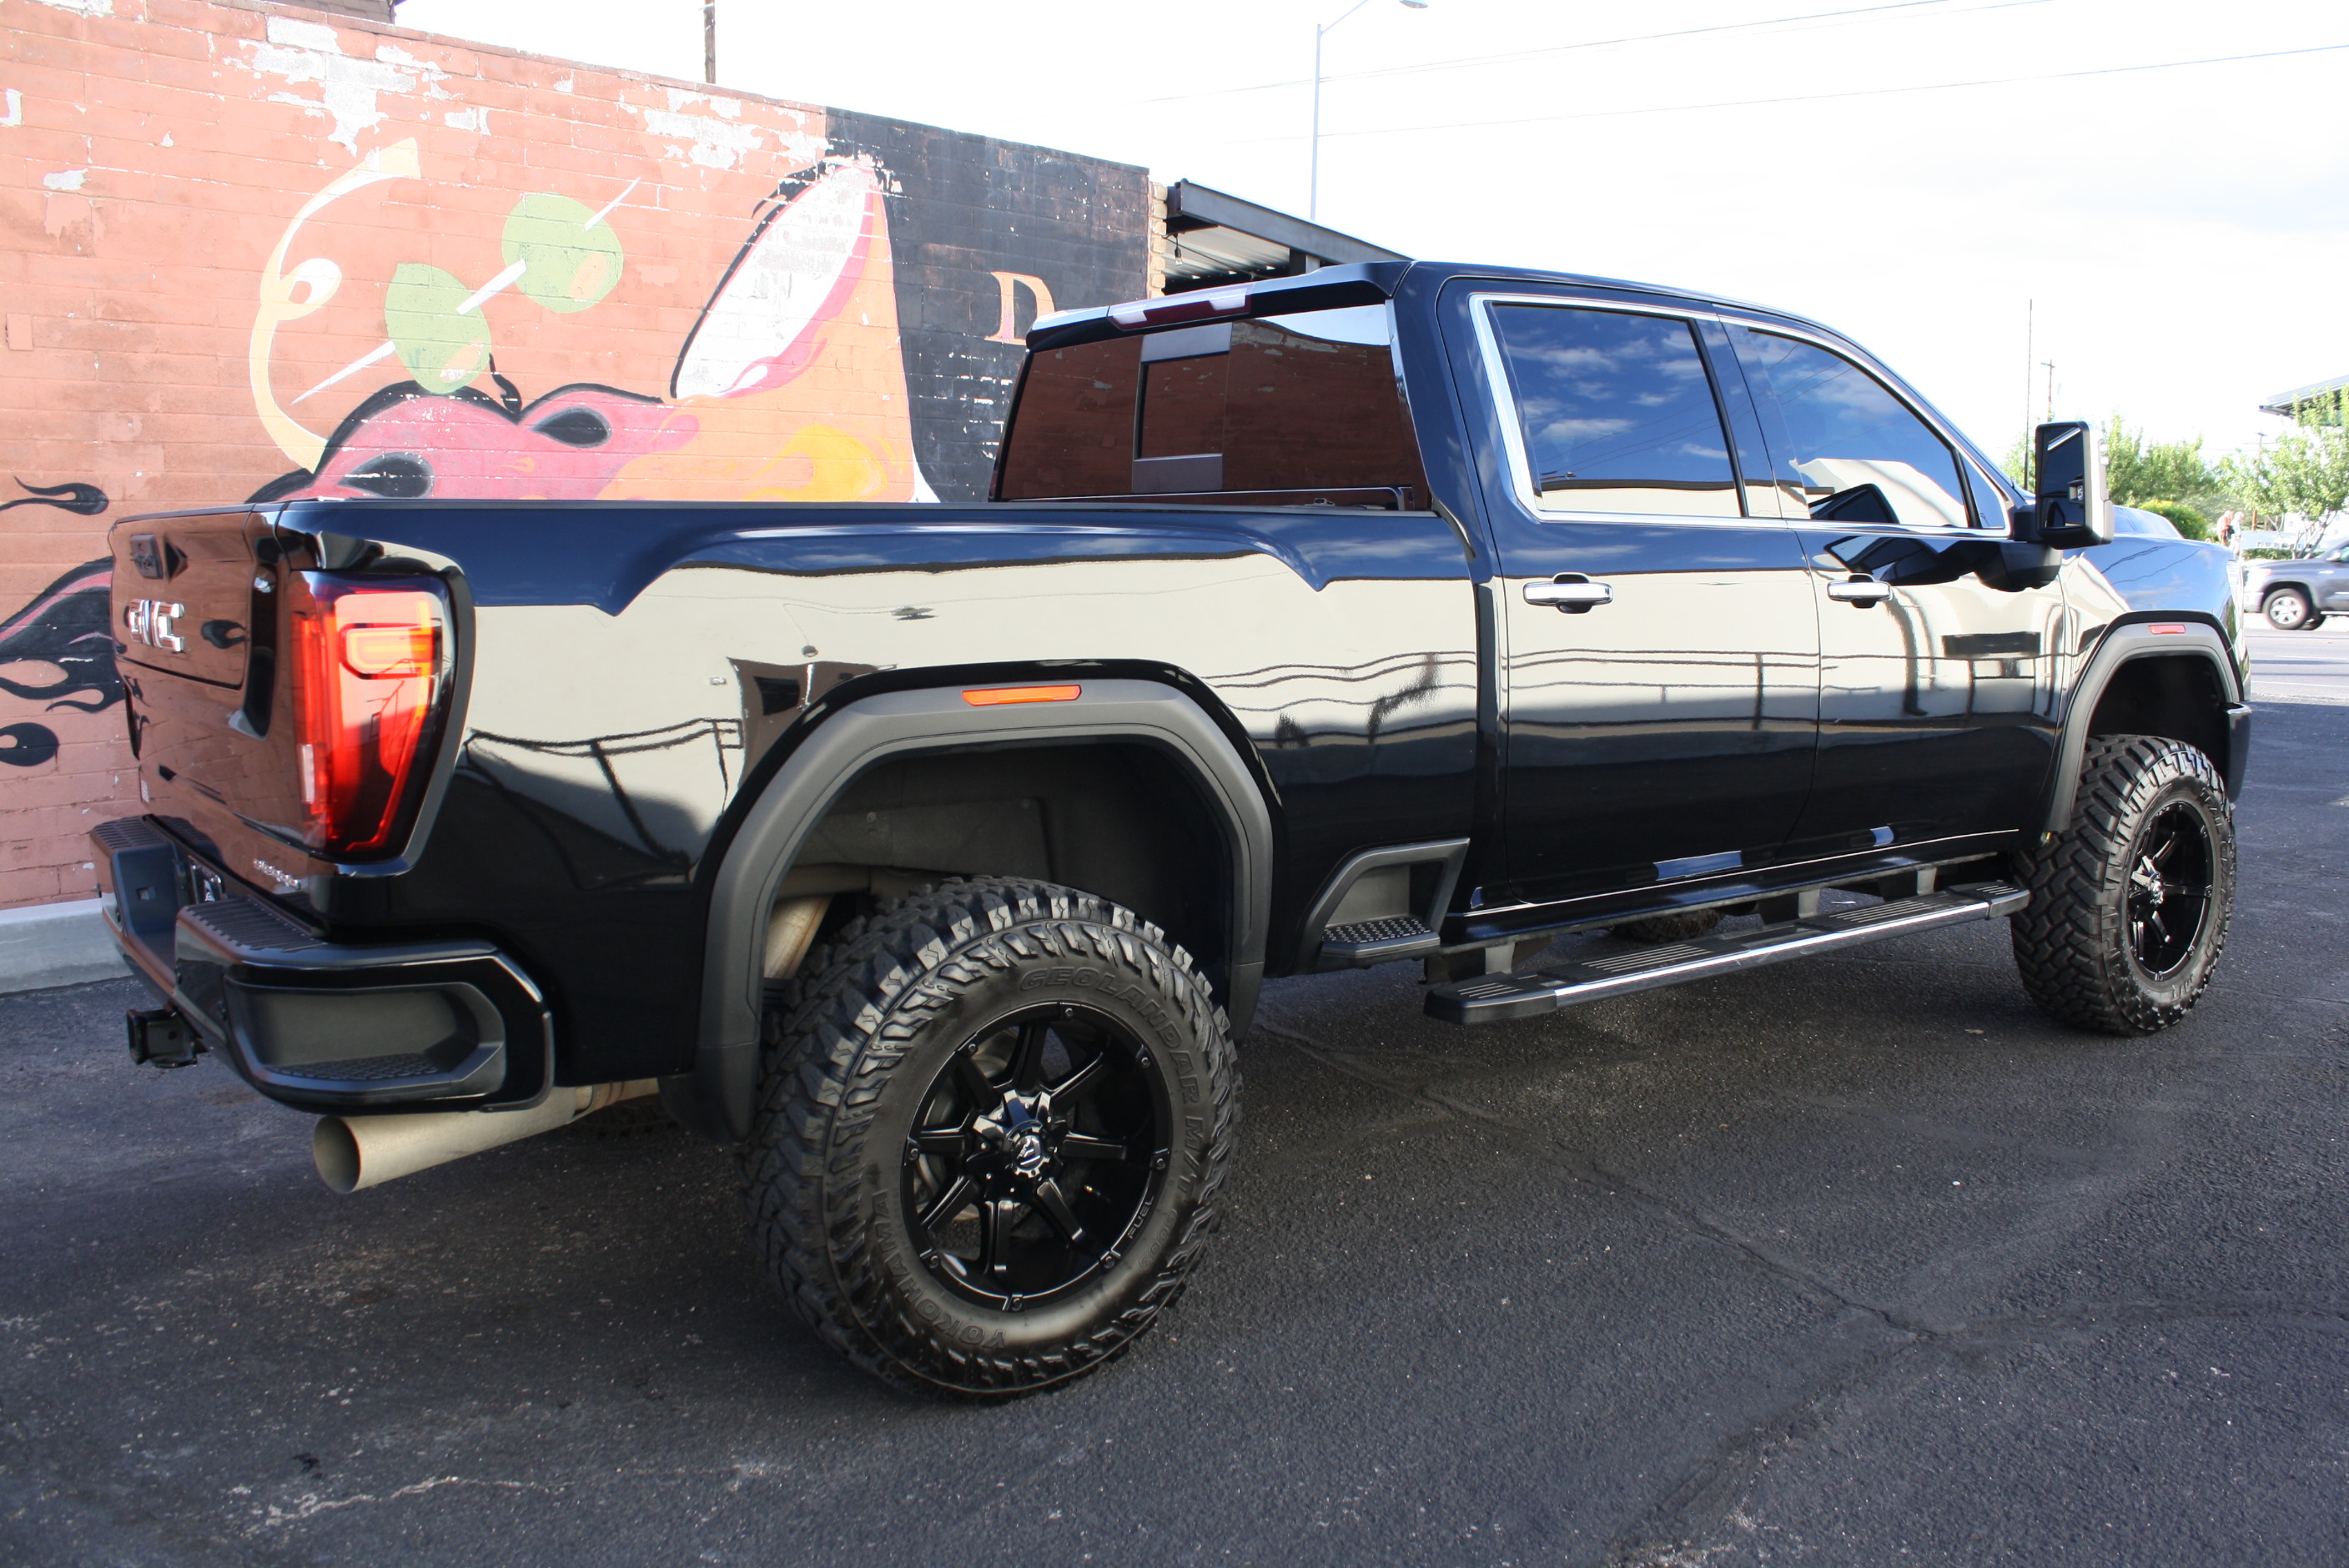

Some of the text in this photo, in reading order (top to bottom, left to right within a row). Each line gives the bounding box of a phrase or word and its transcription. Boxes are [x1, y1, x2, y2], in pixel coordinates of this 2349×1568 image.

[1019, 966, 1200, 1104] GEOLANDAR
[871, 1189, 1006, 1349] YOKOHAMA
[1127, 1195, 1154, 1239] FUEL
